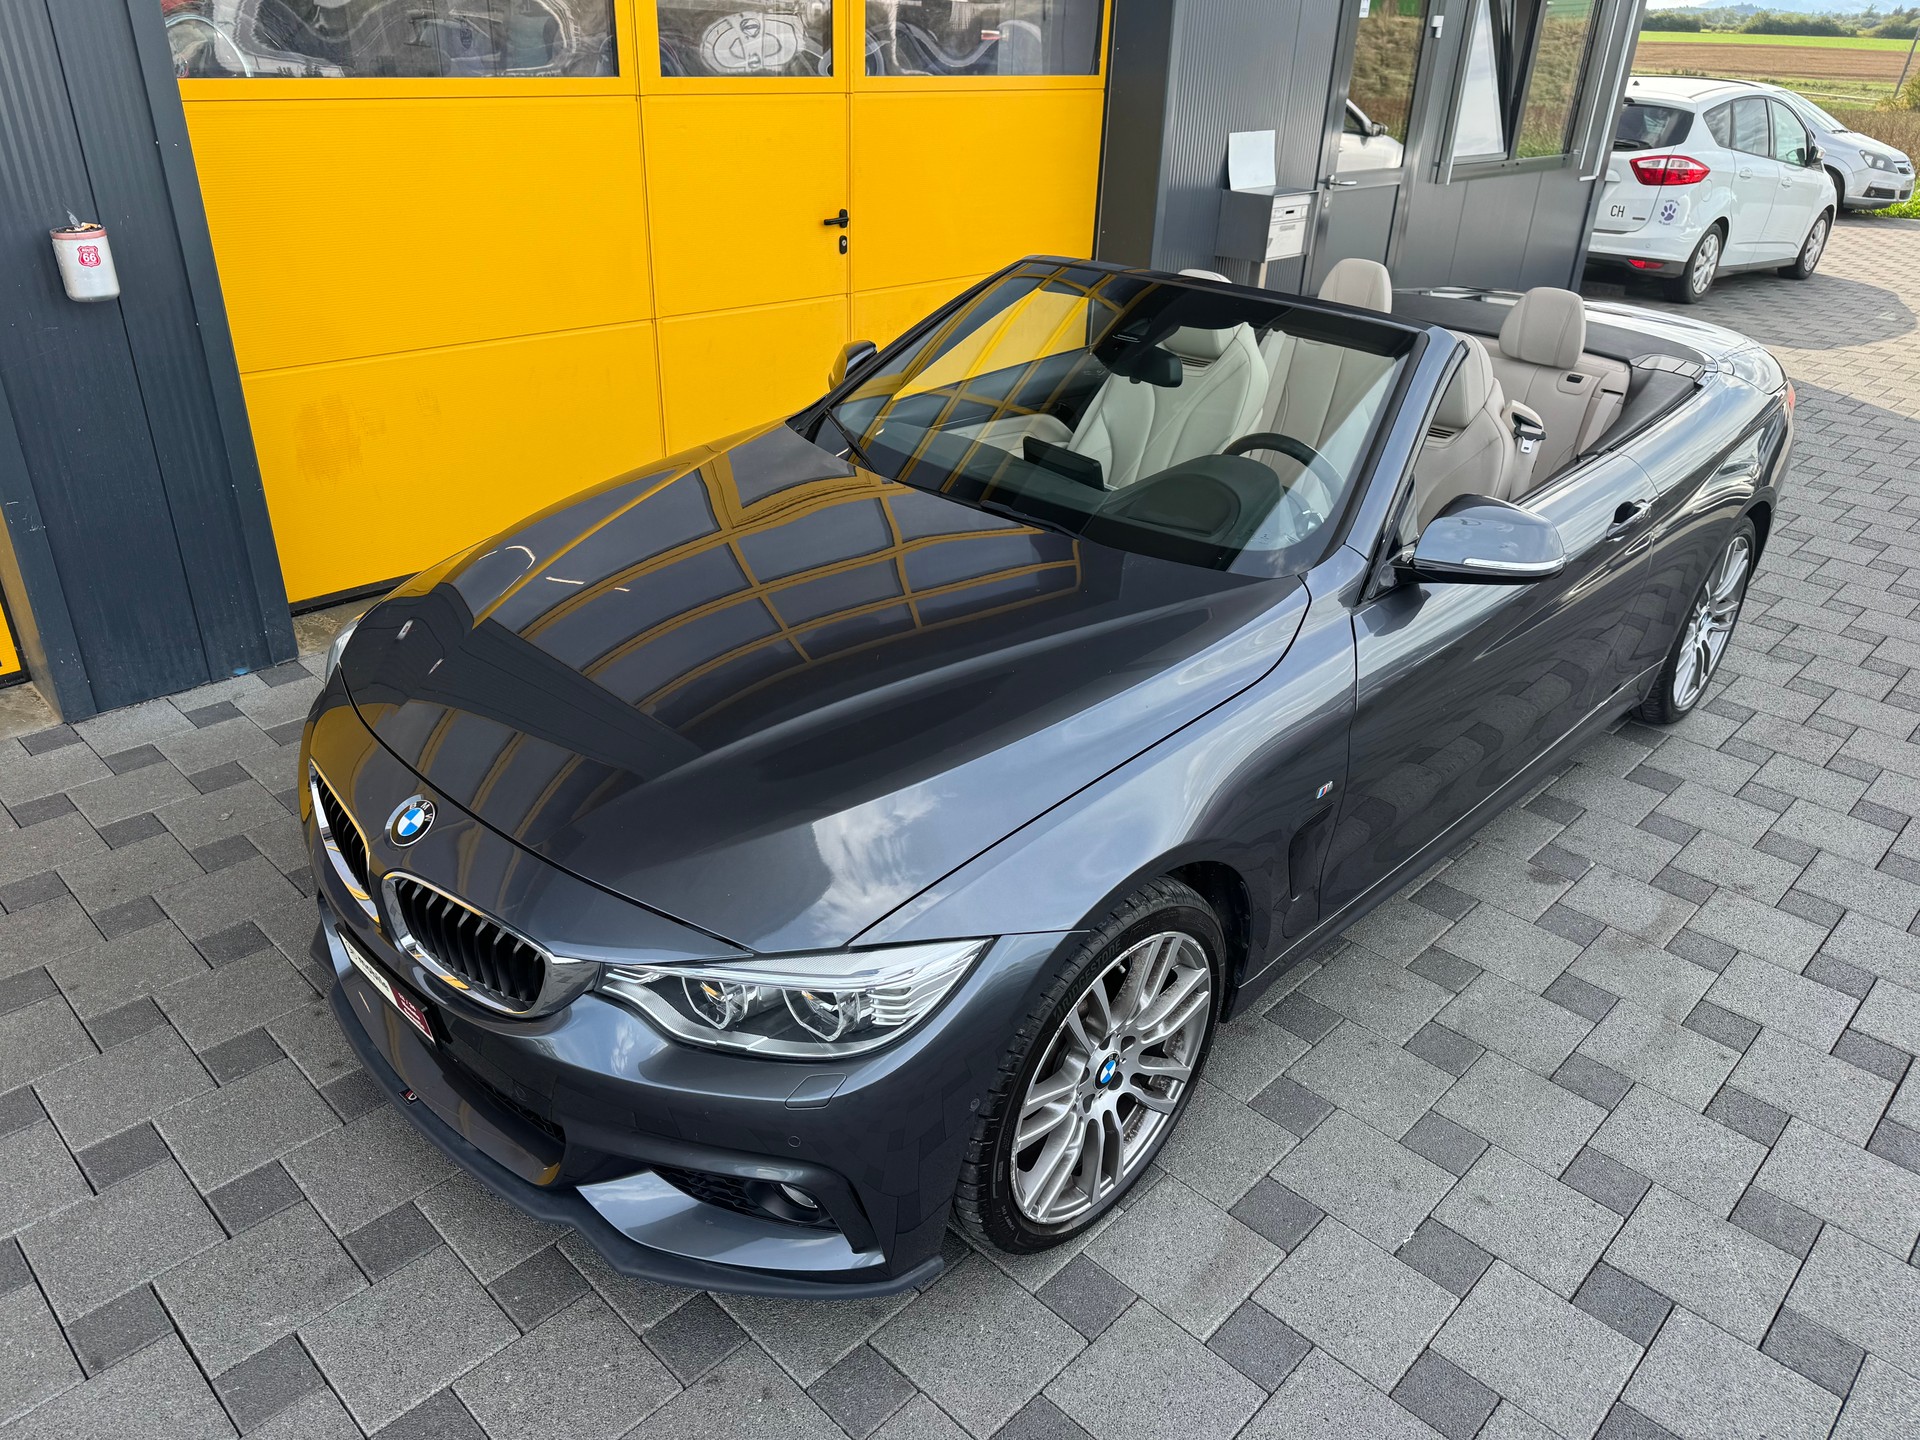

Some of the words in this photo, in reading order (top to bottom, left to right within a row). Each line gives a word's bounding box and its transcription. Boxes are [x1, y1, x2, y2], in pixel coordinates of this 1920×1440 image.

[1610, 204, 1626, 218] CH
[83, 252, 97, 262] 66
[1053, 940, 1121, 1022] BRIDGESTONE
